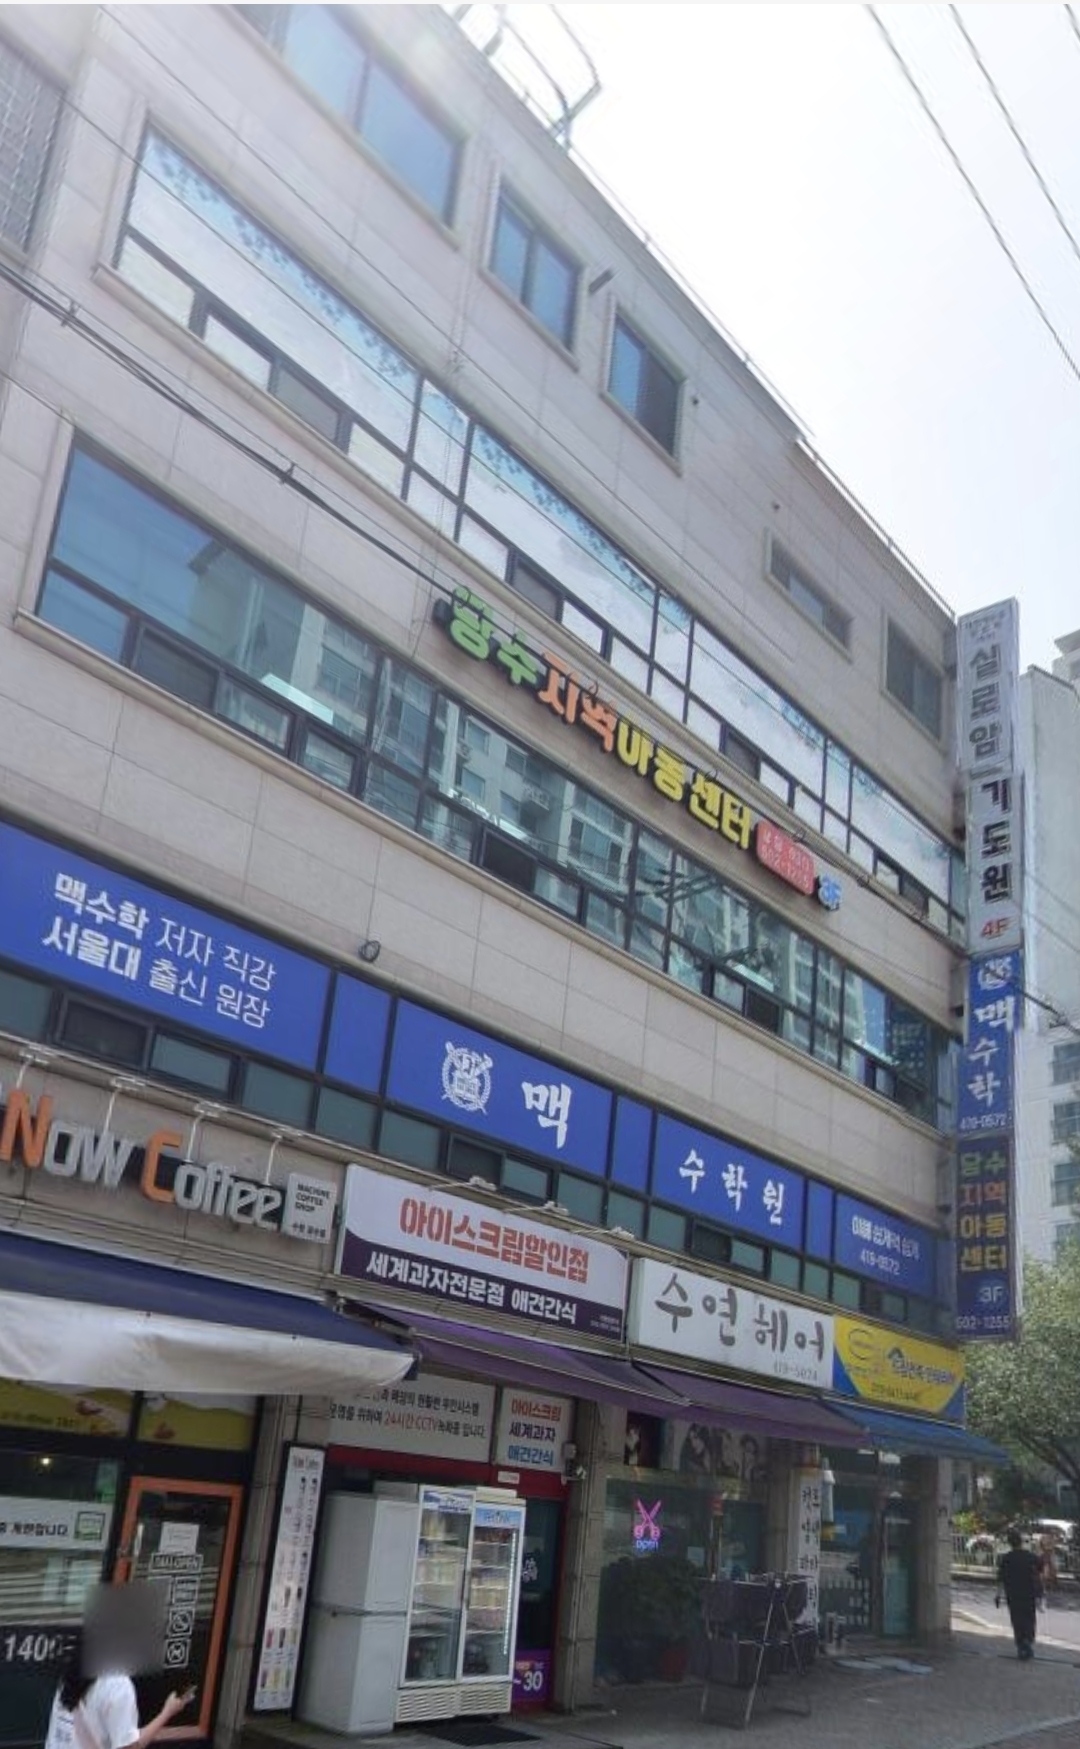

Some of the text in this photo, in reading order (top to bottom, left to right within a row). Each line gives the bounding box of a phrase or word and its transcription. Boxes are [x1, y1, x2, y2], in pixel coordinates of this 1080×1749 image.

[981, 778, 1012, 902] 기도원
[54, 873, 277, 992] 맥수학 저자 직강
[981, 917, 1012, 939] 4F
[42, 915, 272, 1029] 서울대 출신 원장
[965, 995, 1015, 1108] 맥수학
[521, 1081, 571, 1149] 맥
[140, 1129, 282, 1231] Coffee
[959, 1179, 1007, 1207] 지역
[399, 1197, 590, 1284] 아이스크림할인점
[960, 1212, 1007, 1239] 아동
[960, 1245, 1008, 1272] 센터
[366, 1250, 577, 1325] 세계과자전문점 애견간식
[654, 1272, 738, 1347] 수연
[751, 1302, 825, 1363] 헤어
[978, 1285, 1004, 1303] 3F
[509, 1422, 556, 1442] 세계과자
[511, 1399, 562, 1422] 아이스크림
[508, 1445, 554, 1467] 애견간식
